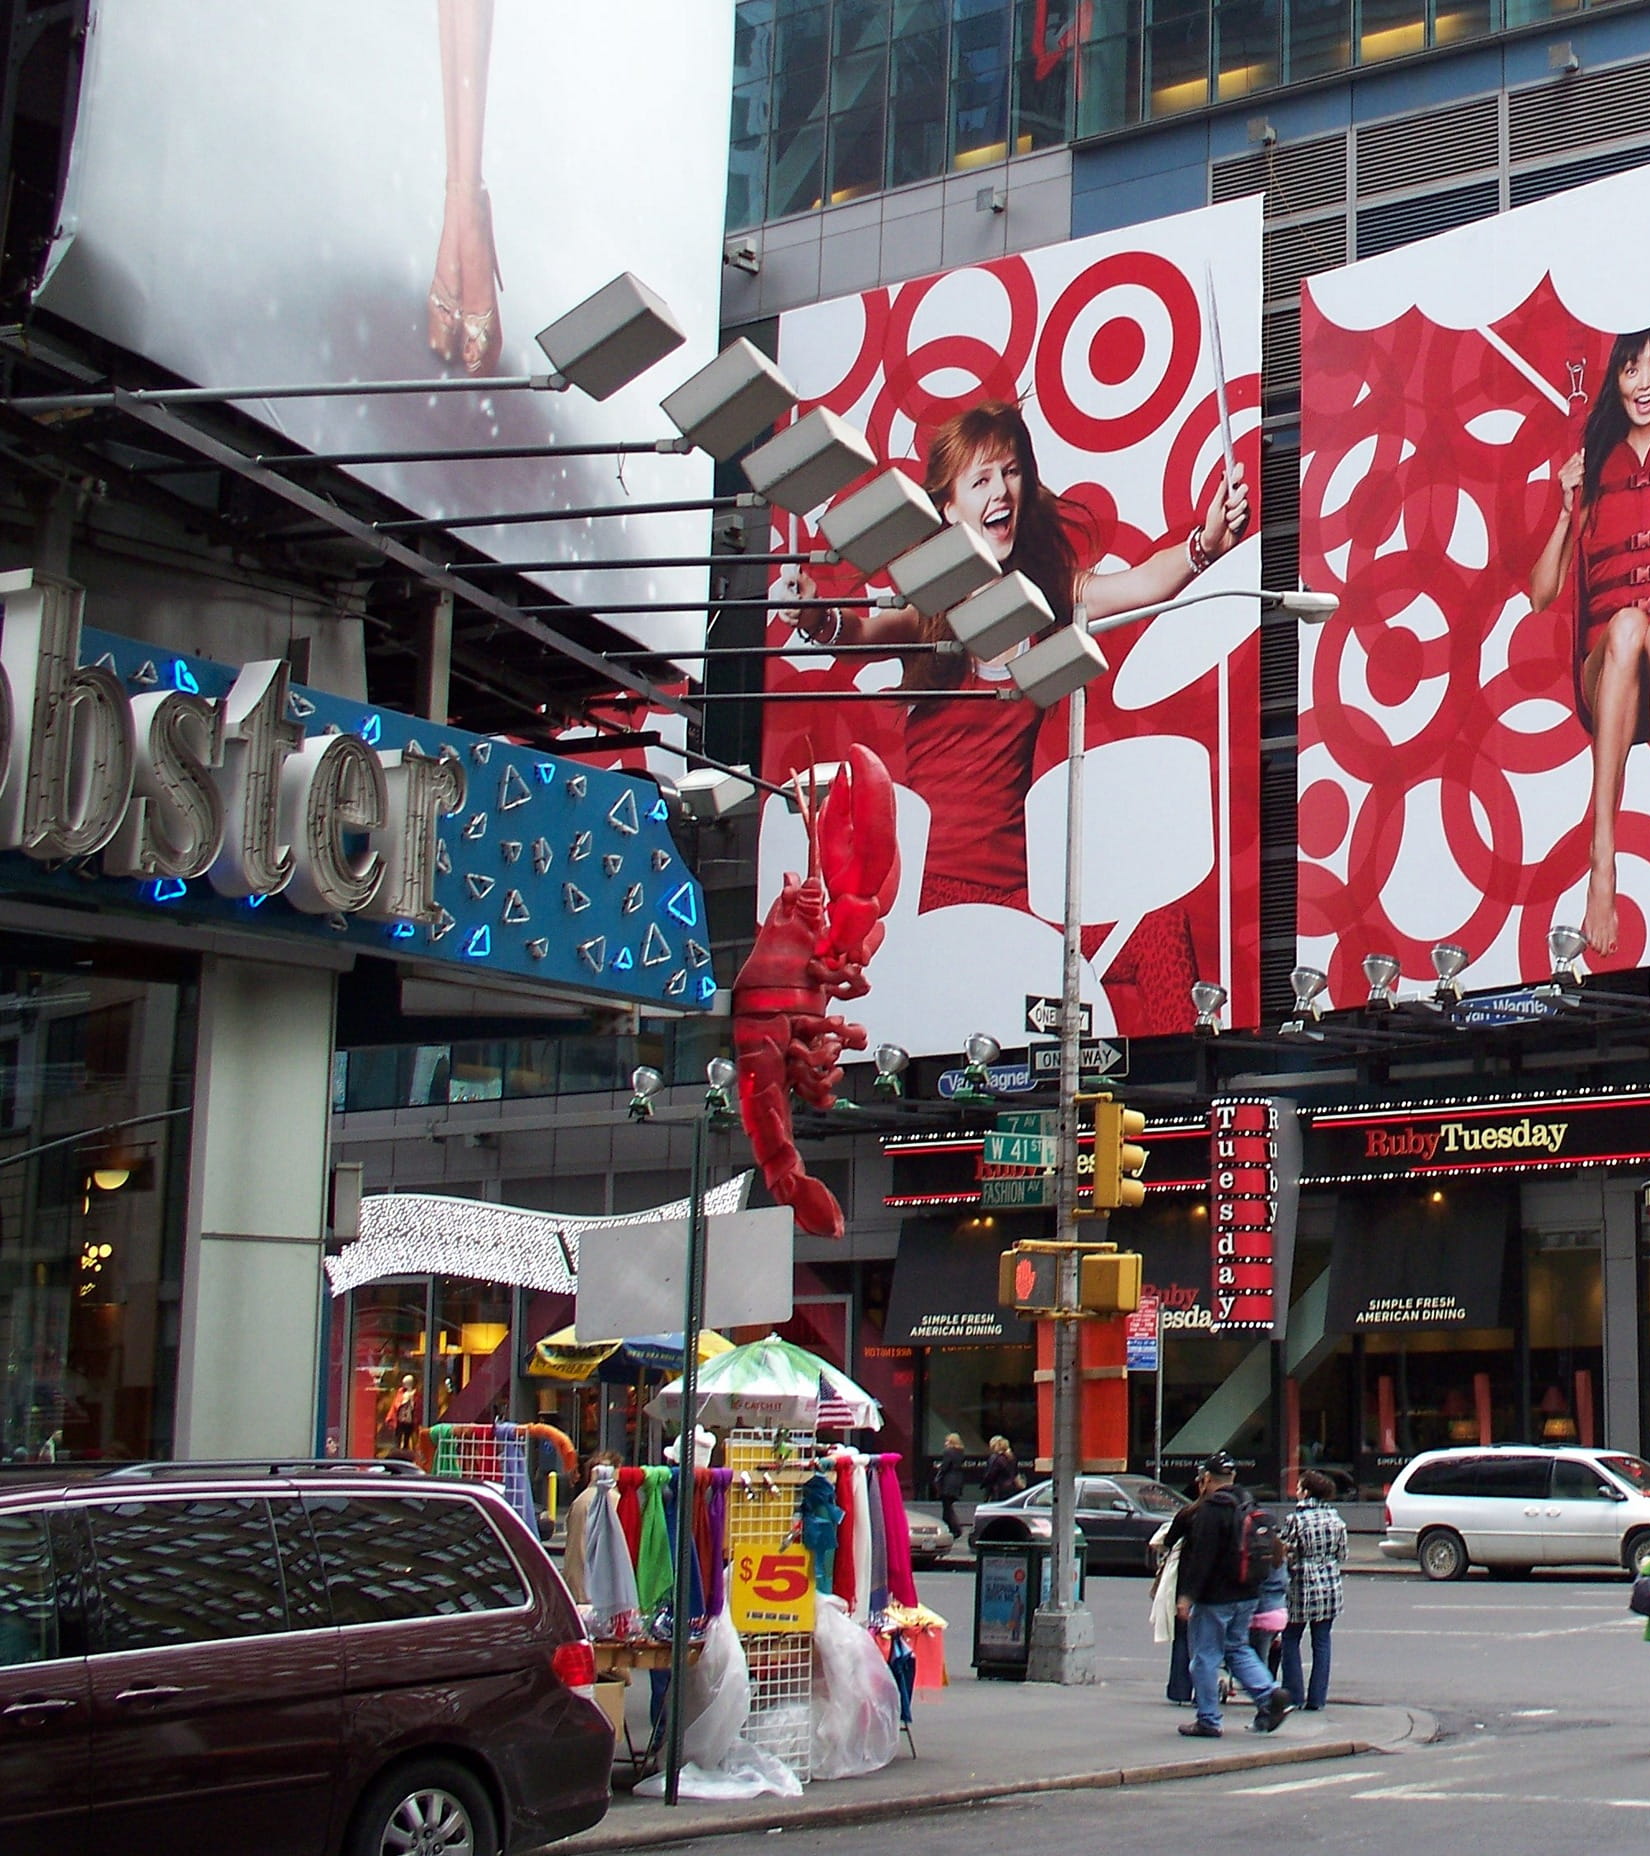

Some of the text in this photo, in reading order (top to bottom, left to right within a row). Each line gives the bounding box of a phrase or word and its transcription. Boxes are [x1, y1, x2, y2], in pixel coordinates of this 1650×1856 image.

[0, 568, 468, 925] bster
[1035, 1007, 1057, 1024] ONE
[1042, 1049, 1112, 1068] ON WAY
[988, 1069, 1030, 1091] agner
[1007, 1115, 1037, 1134] 7 AV
[991, 1136, 1043, 1162] W 41 ST
[1268, 1107, 1279, 1224] Ruby
[982, 1179, 1041, 1205] FASHION AV
[1216, 1106, 1236, 1321] Tuesday
[1368, 1296, 1455, 1311] SIMPLE FRESH
[921, 1313, 994, 1326] SIMPLE FRESH
[1356, 1307, 1466, 1323] AMERICAN DINING
[910, 1323, 1003, 1338] AMERICAN DINING
